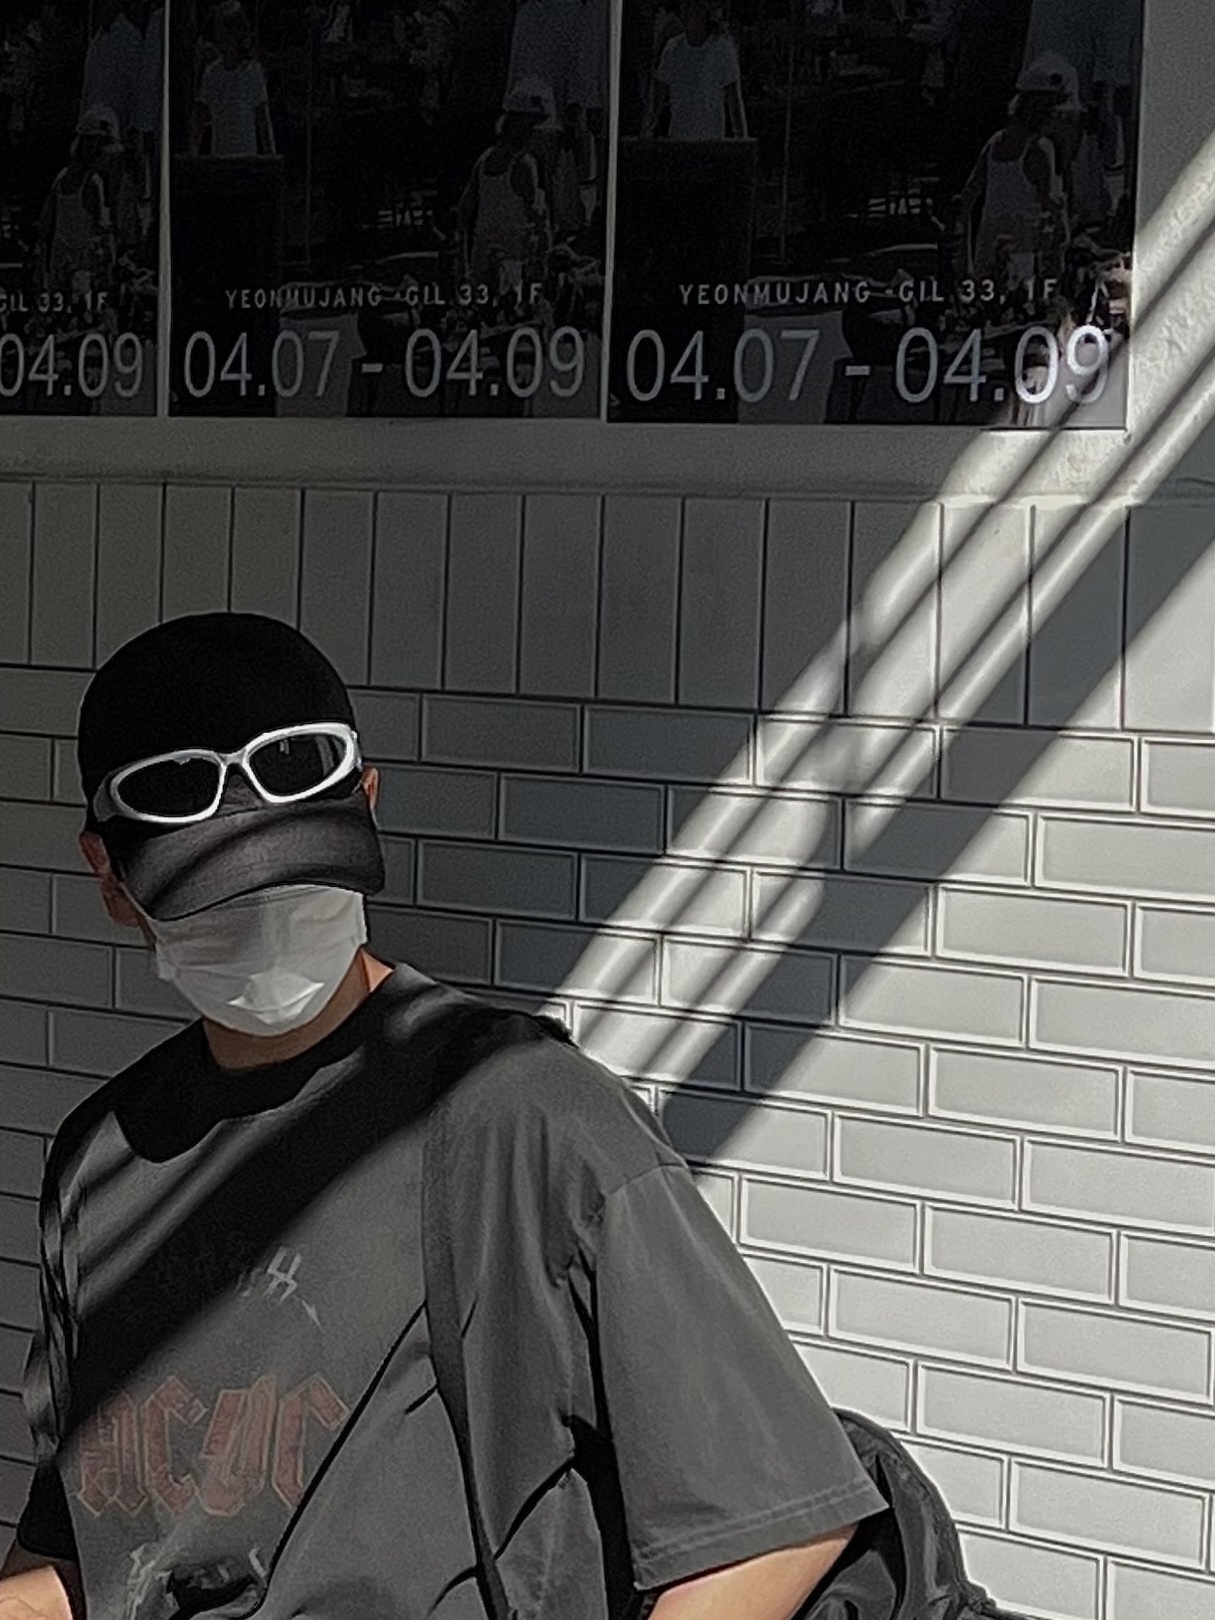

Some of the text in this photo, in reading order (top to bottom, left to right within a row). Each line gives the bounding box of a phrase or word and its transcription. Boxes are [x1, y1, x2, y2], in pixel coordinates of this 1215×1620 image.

[183, 329, 341, 399] 04.07
[404, 325, 585, 399] 04.09
[625, 327, 820, 404] 04.07
[894, 323, 1110, 406] 04.09
